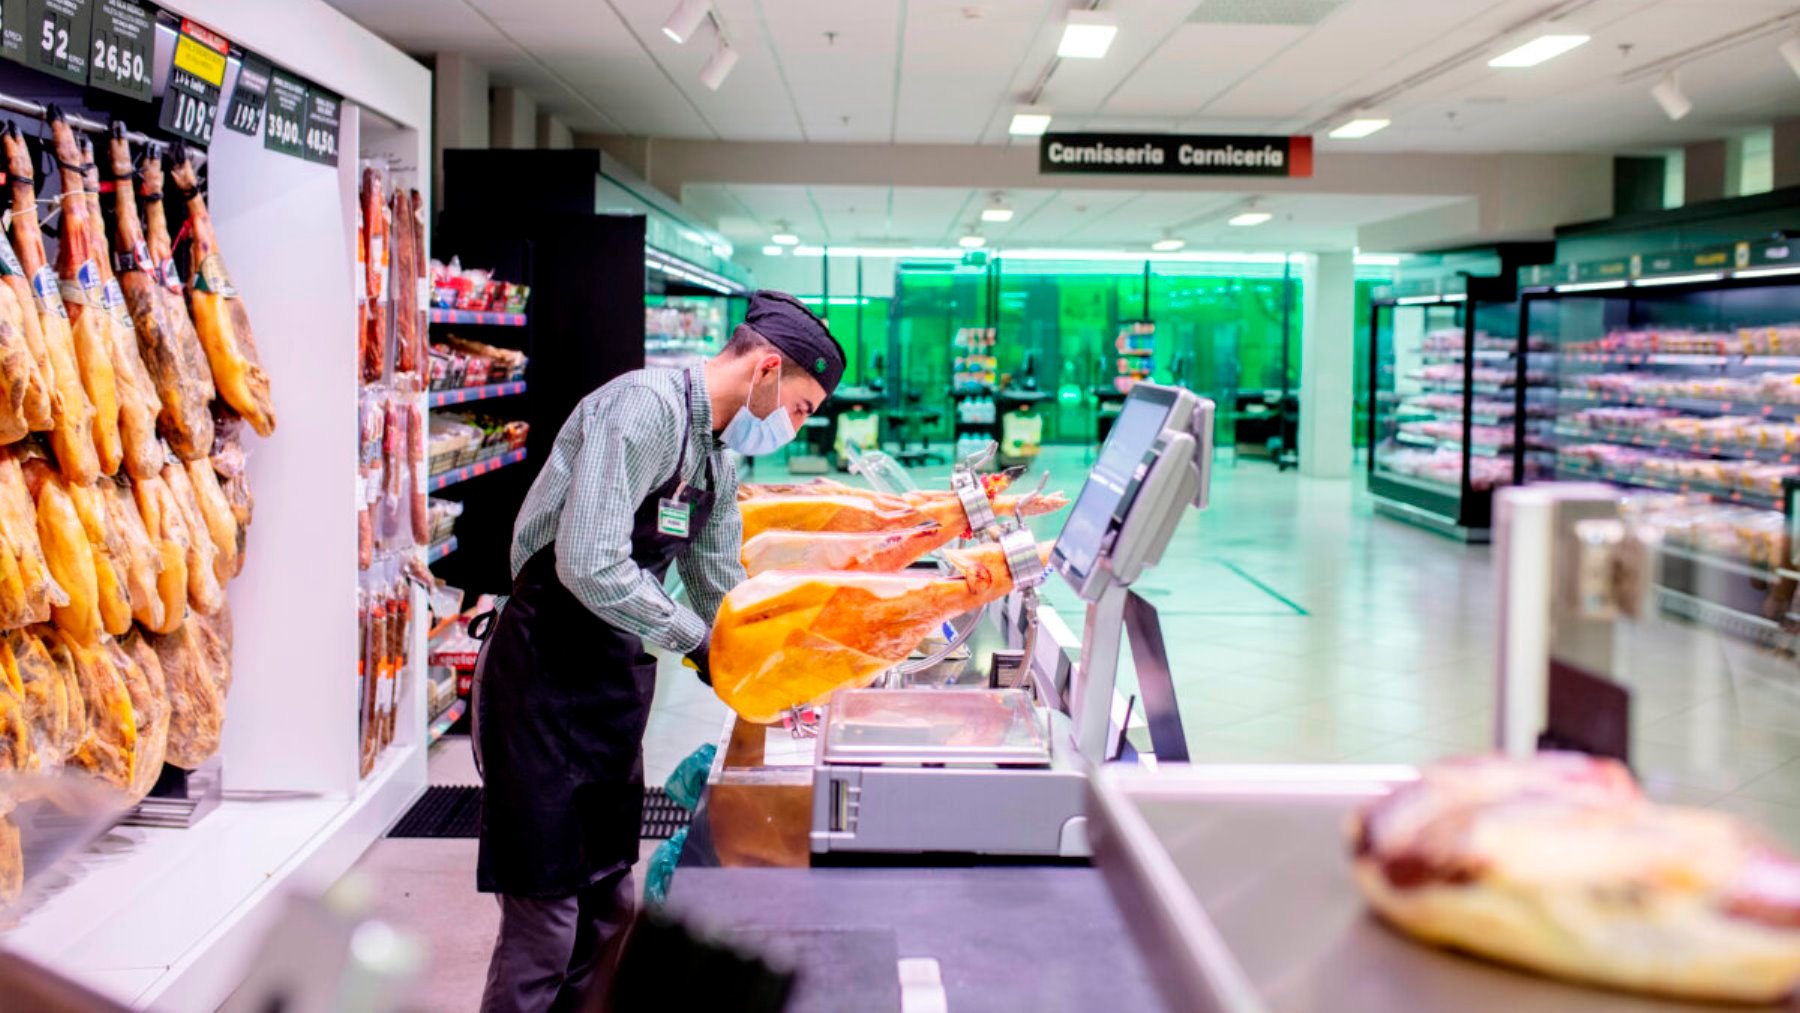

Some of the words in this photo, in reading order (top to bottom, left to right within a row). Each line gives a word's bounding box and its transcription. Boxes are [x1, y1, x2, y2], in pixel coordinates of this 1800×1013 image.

[41, 20, 69, 60] 52
[93, 39, 144, 82] 26,50
[268, 113, 299, 144] 39,00
[1048, 142, 1165, 164] Carnisseria
[1178, 145, 1284, 166] Carnicería
